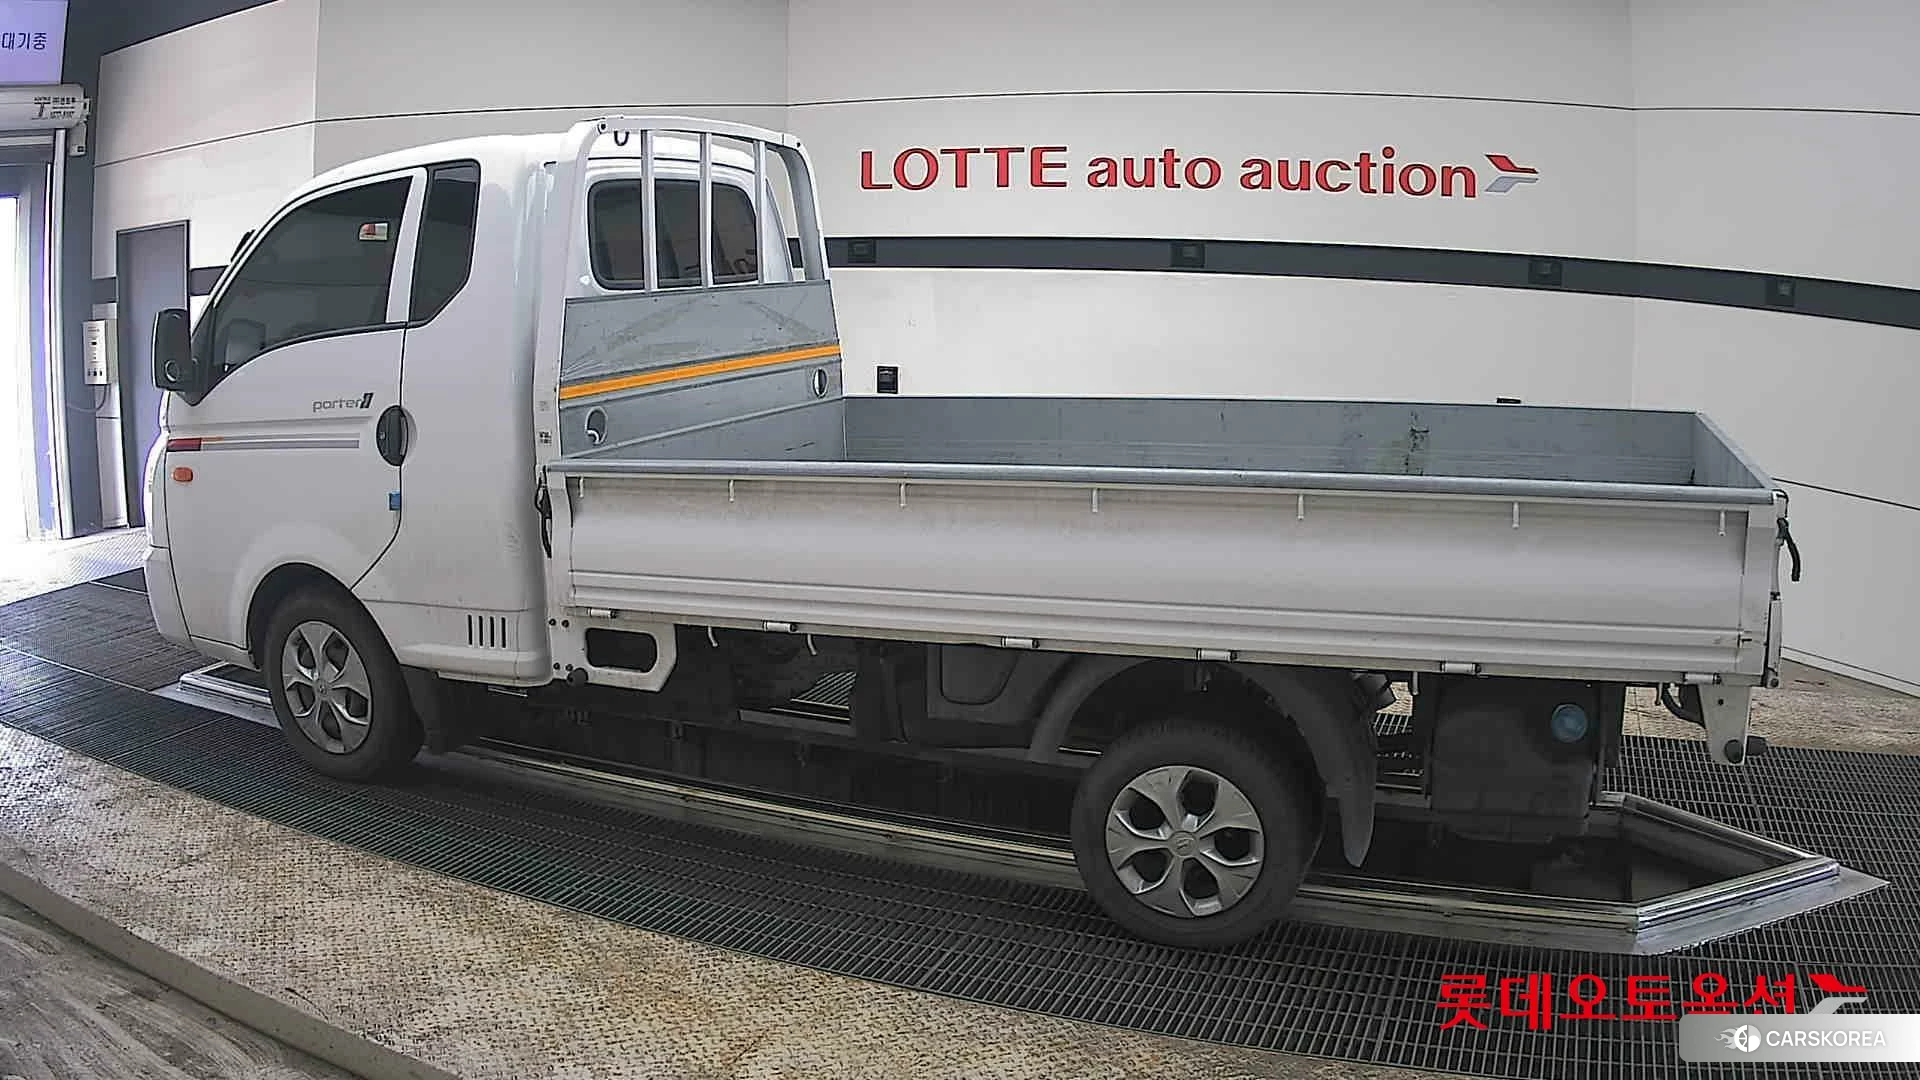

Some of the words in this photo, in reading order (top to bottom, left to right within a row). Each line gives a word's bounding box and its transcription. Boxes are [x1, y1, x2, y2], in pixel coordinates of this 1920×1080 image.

[1, 32, 47, 50] 대기중
[860, 146, 1067, 190] LOTTE
[1087, 149, 1222, 189] auto
[1240, 147, 1477, 198] auction
